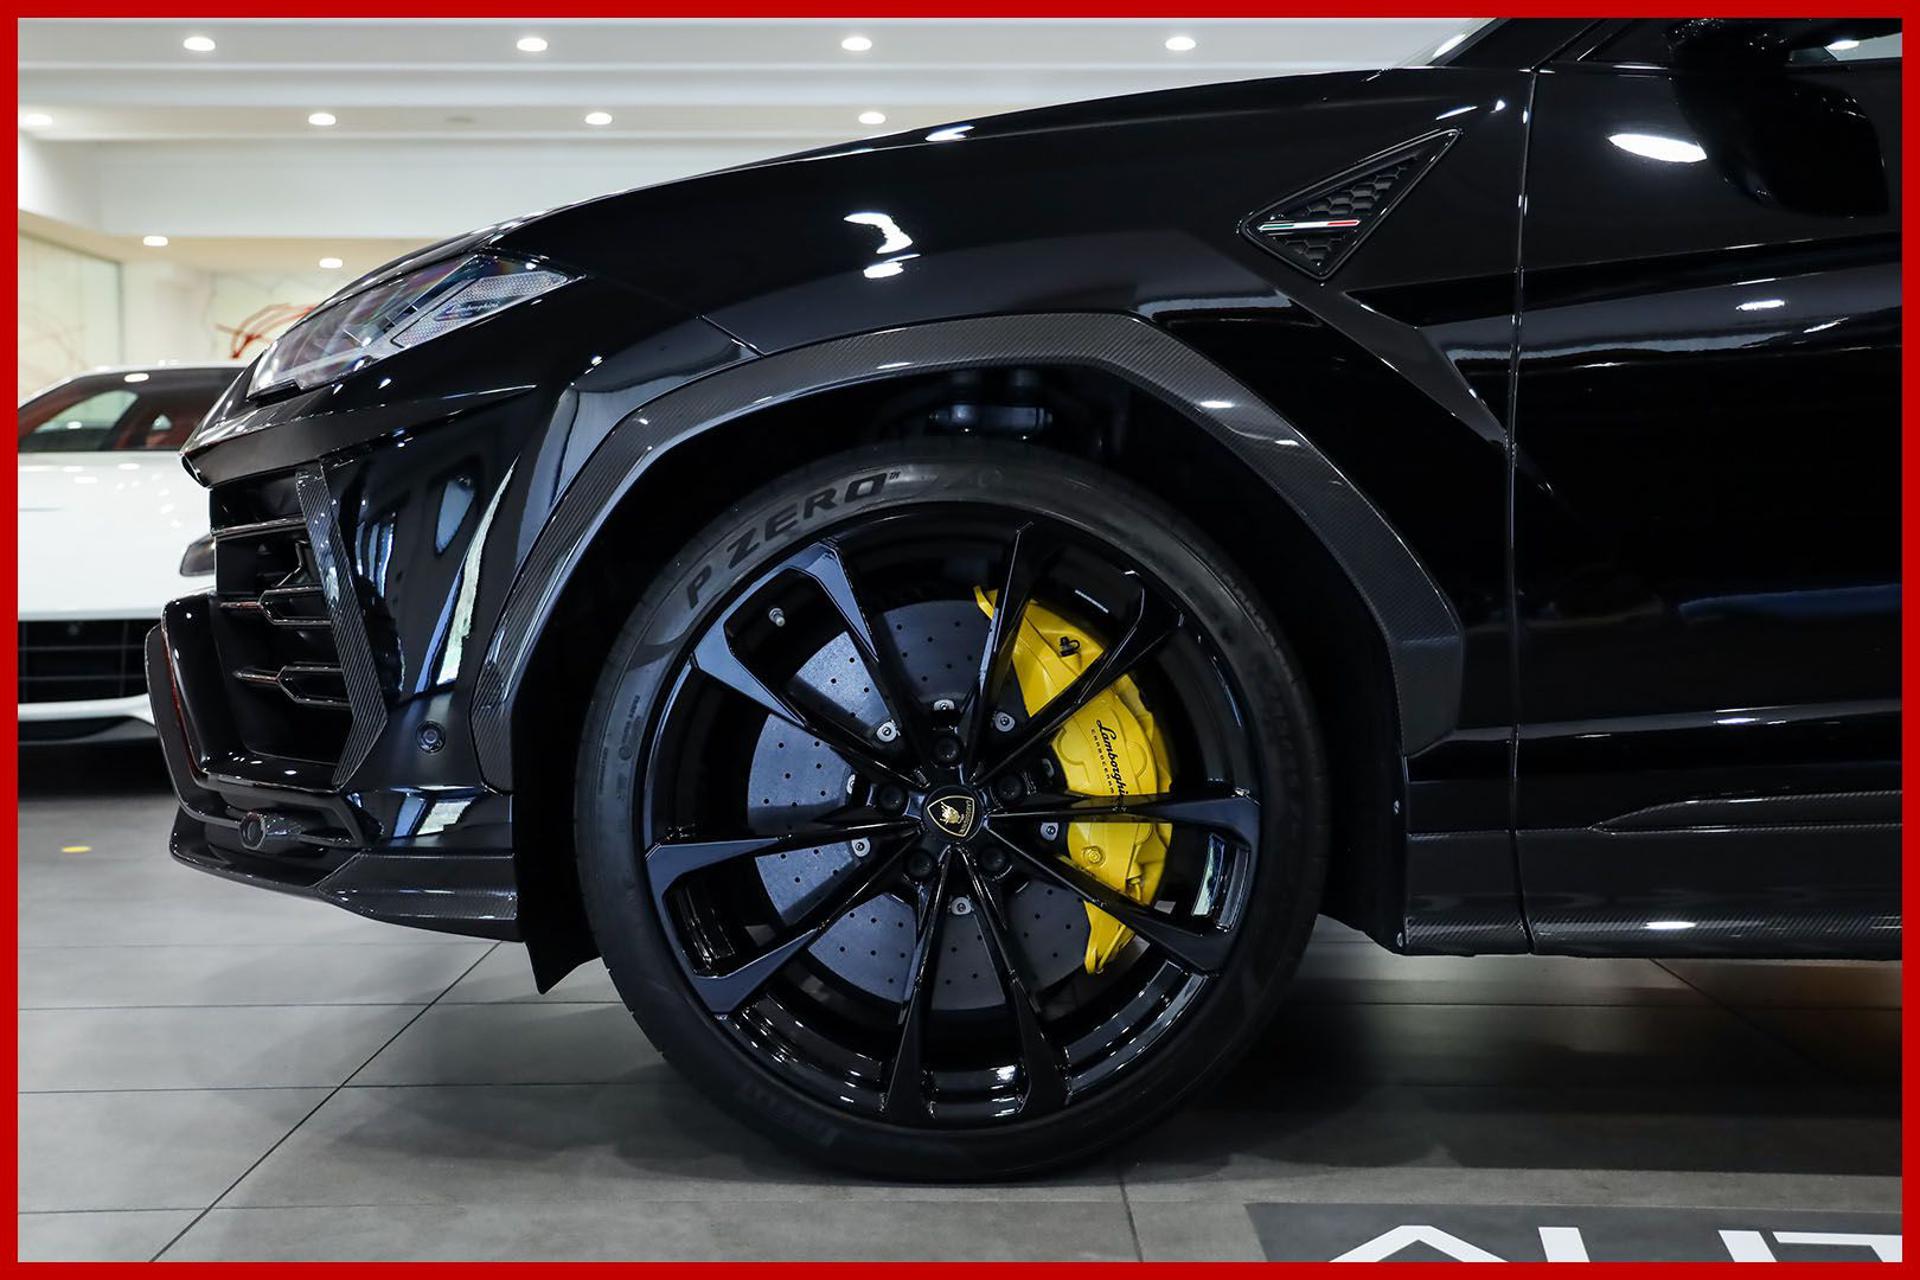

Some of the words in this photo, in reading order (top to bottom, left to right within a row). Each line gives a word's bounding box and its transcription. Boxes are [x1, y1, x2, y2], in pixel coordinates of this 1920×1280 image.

[687, 565, 712, 609] P
[727, 473, 888, 570] ZERO
[1095, 719, 1129, 797] Lamborghi
